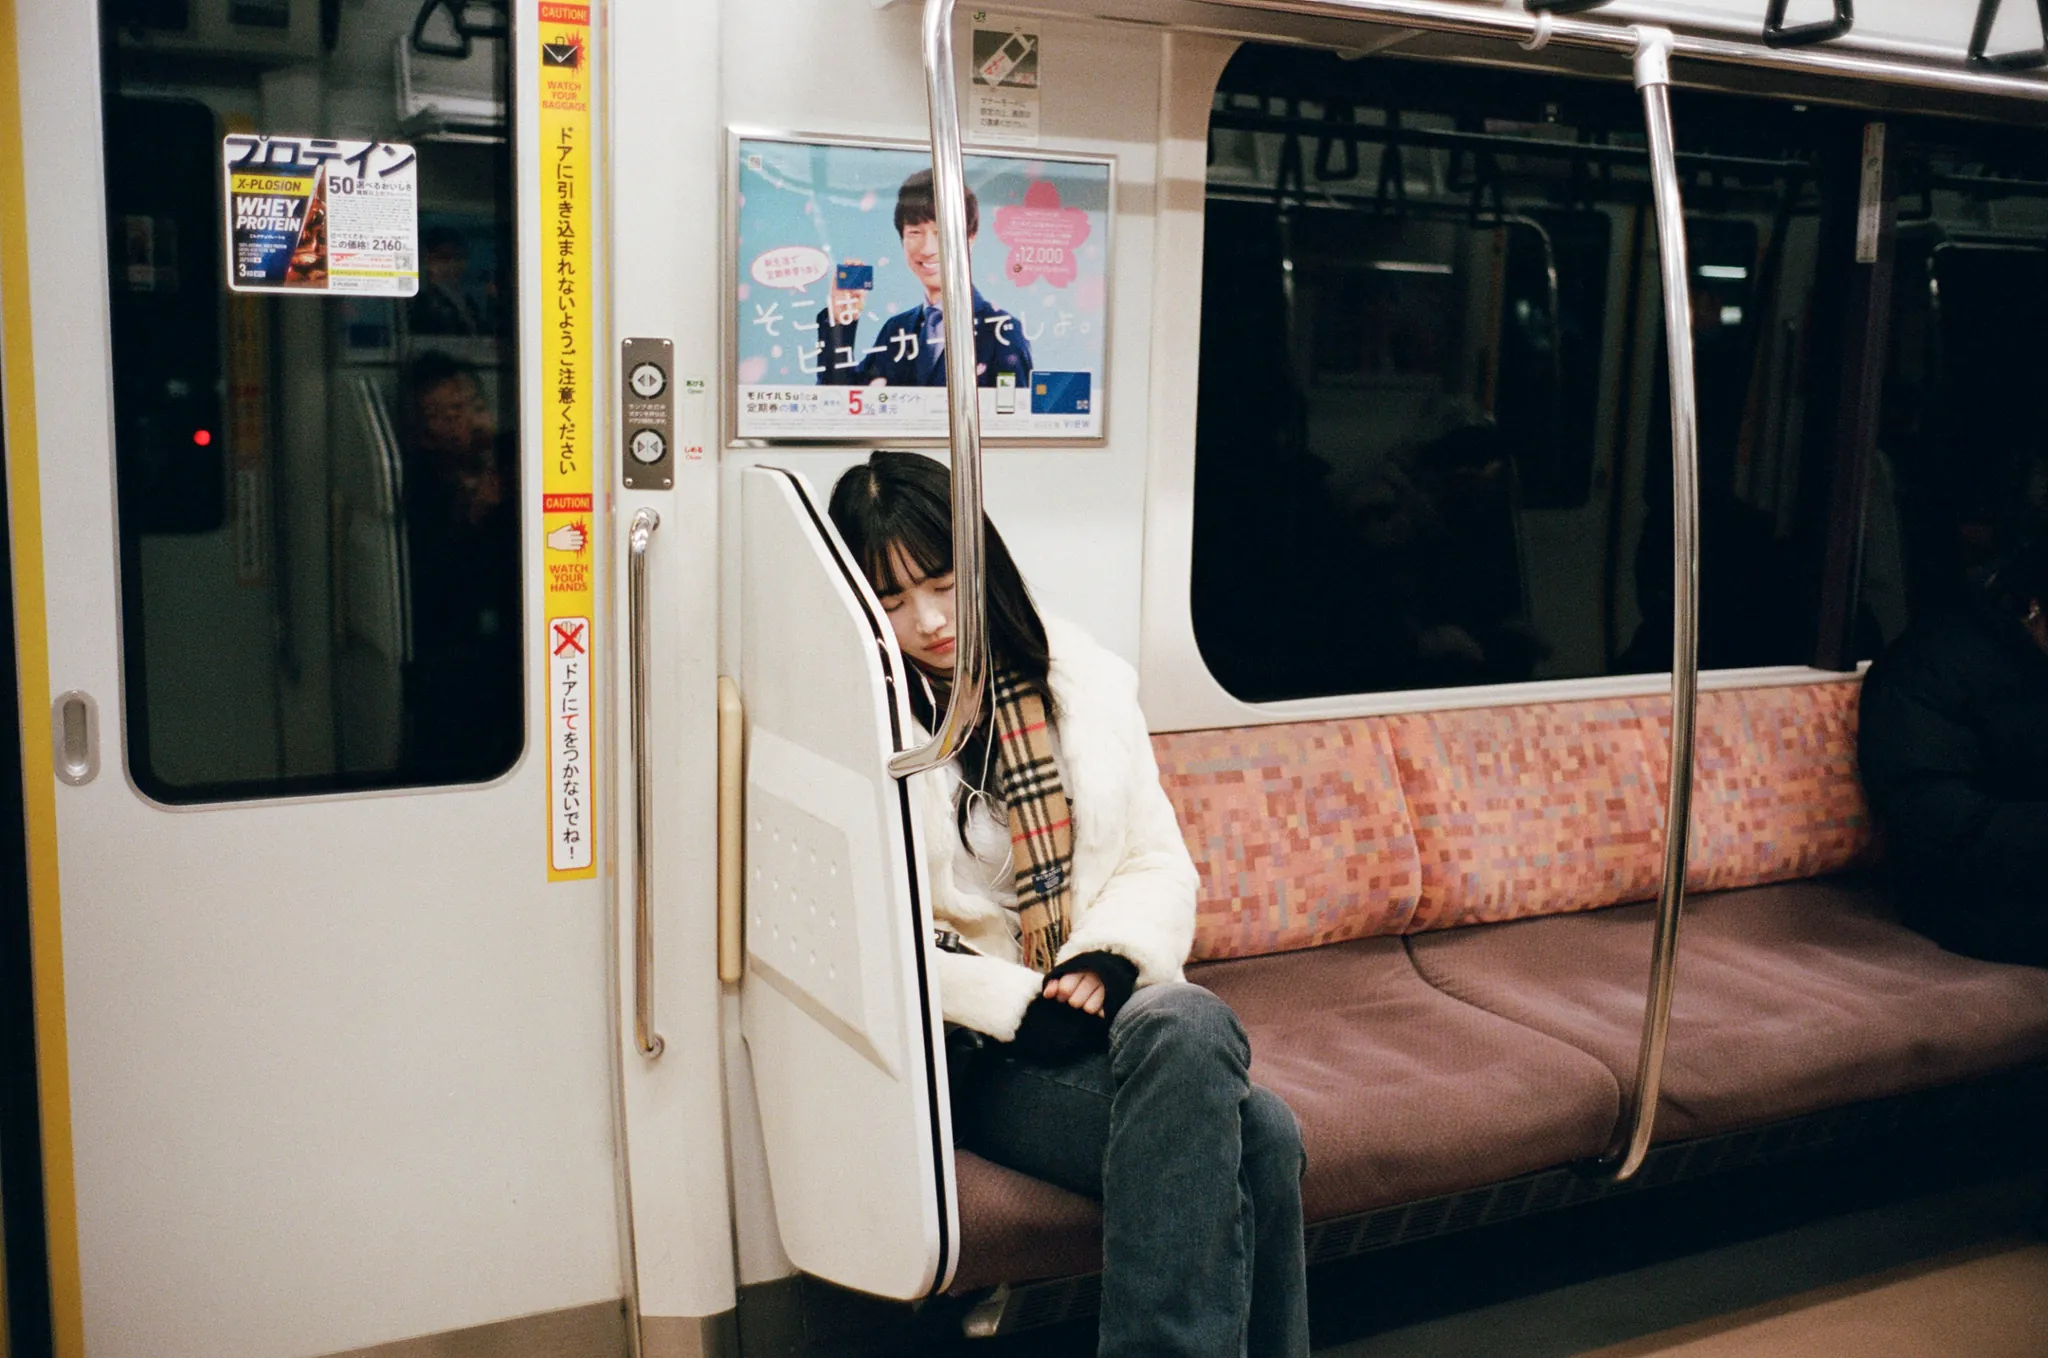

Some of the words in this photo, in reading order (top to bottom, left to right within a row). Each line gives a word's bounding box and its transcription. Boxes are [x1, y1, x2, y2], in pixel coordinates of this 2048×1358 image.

[541, 6, 588, 20] CAUTION!
[547, 80, 582, 91] WATCH
[552, 90, 578, 101] YOUR
[542, 100, 587, 111] BAGGAGE
[225, 135, 416, 179] プロテイン
[237, 178, 302, 192] X-PLOSION
[329, 176, 354, 195] 50
[236, 196, 300, 217] WHEY
[236, 216, 301, 232] PROTEIN
[557, 127, 576, 475] ドアに引き込まれないようご注意ください
[753, 295, 880, 337] そこは、
[798, 310, 1091, 374] ビューカーでしょ。
[546, 498, 590, 509] CAUTION!
[549, 564, 588, 574] WATCH
[554, 573, 584, 582] YOUR
[550, 582, 588, 592] HANDS
[560, 663, 581, 860] ドアにてをつかないでね!
